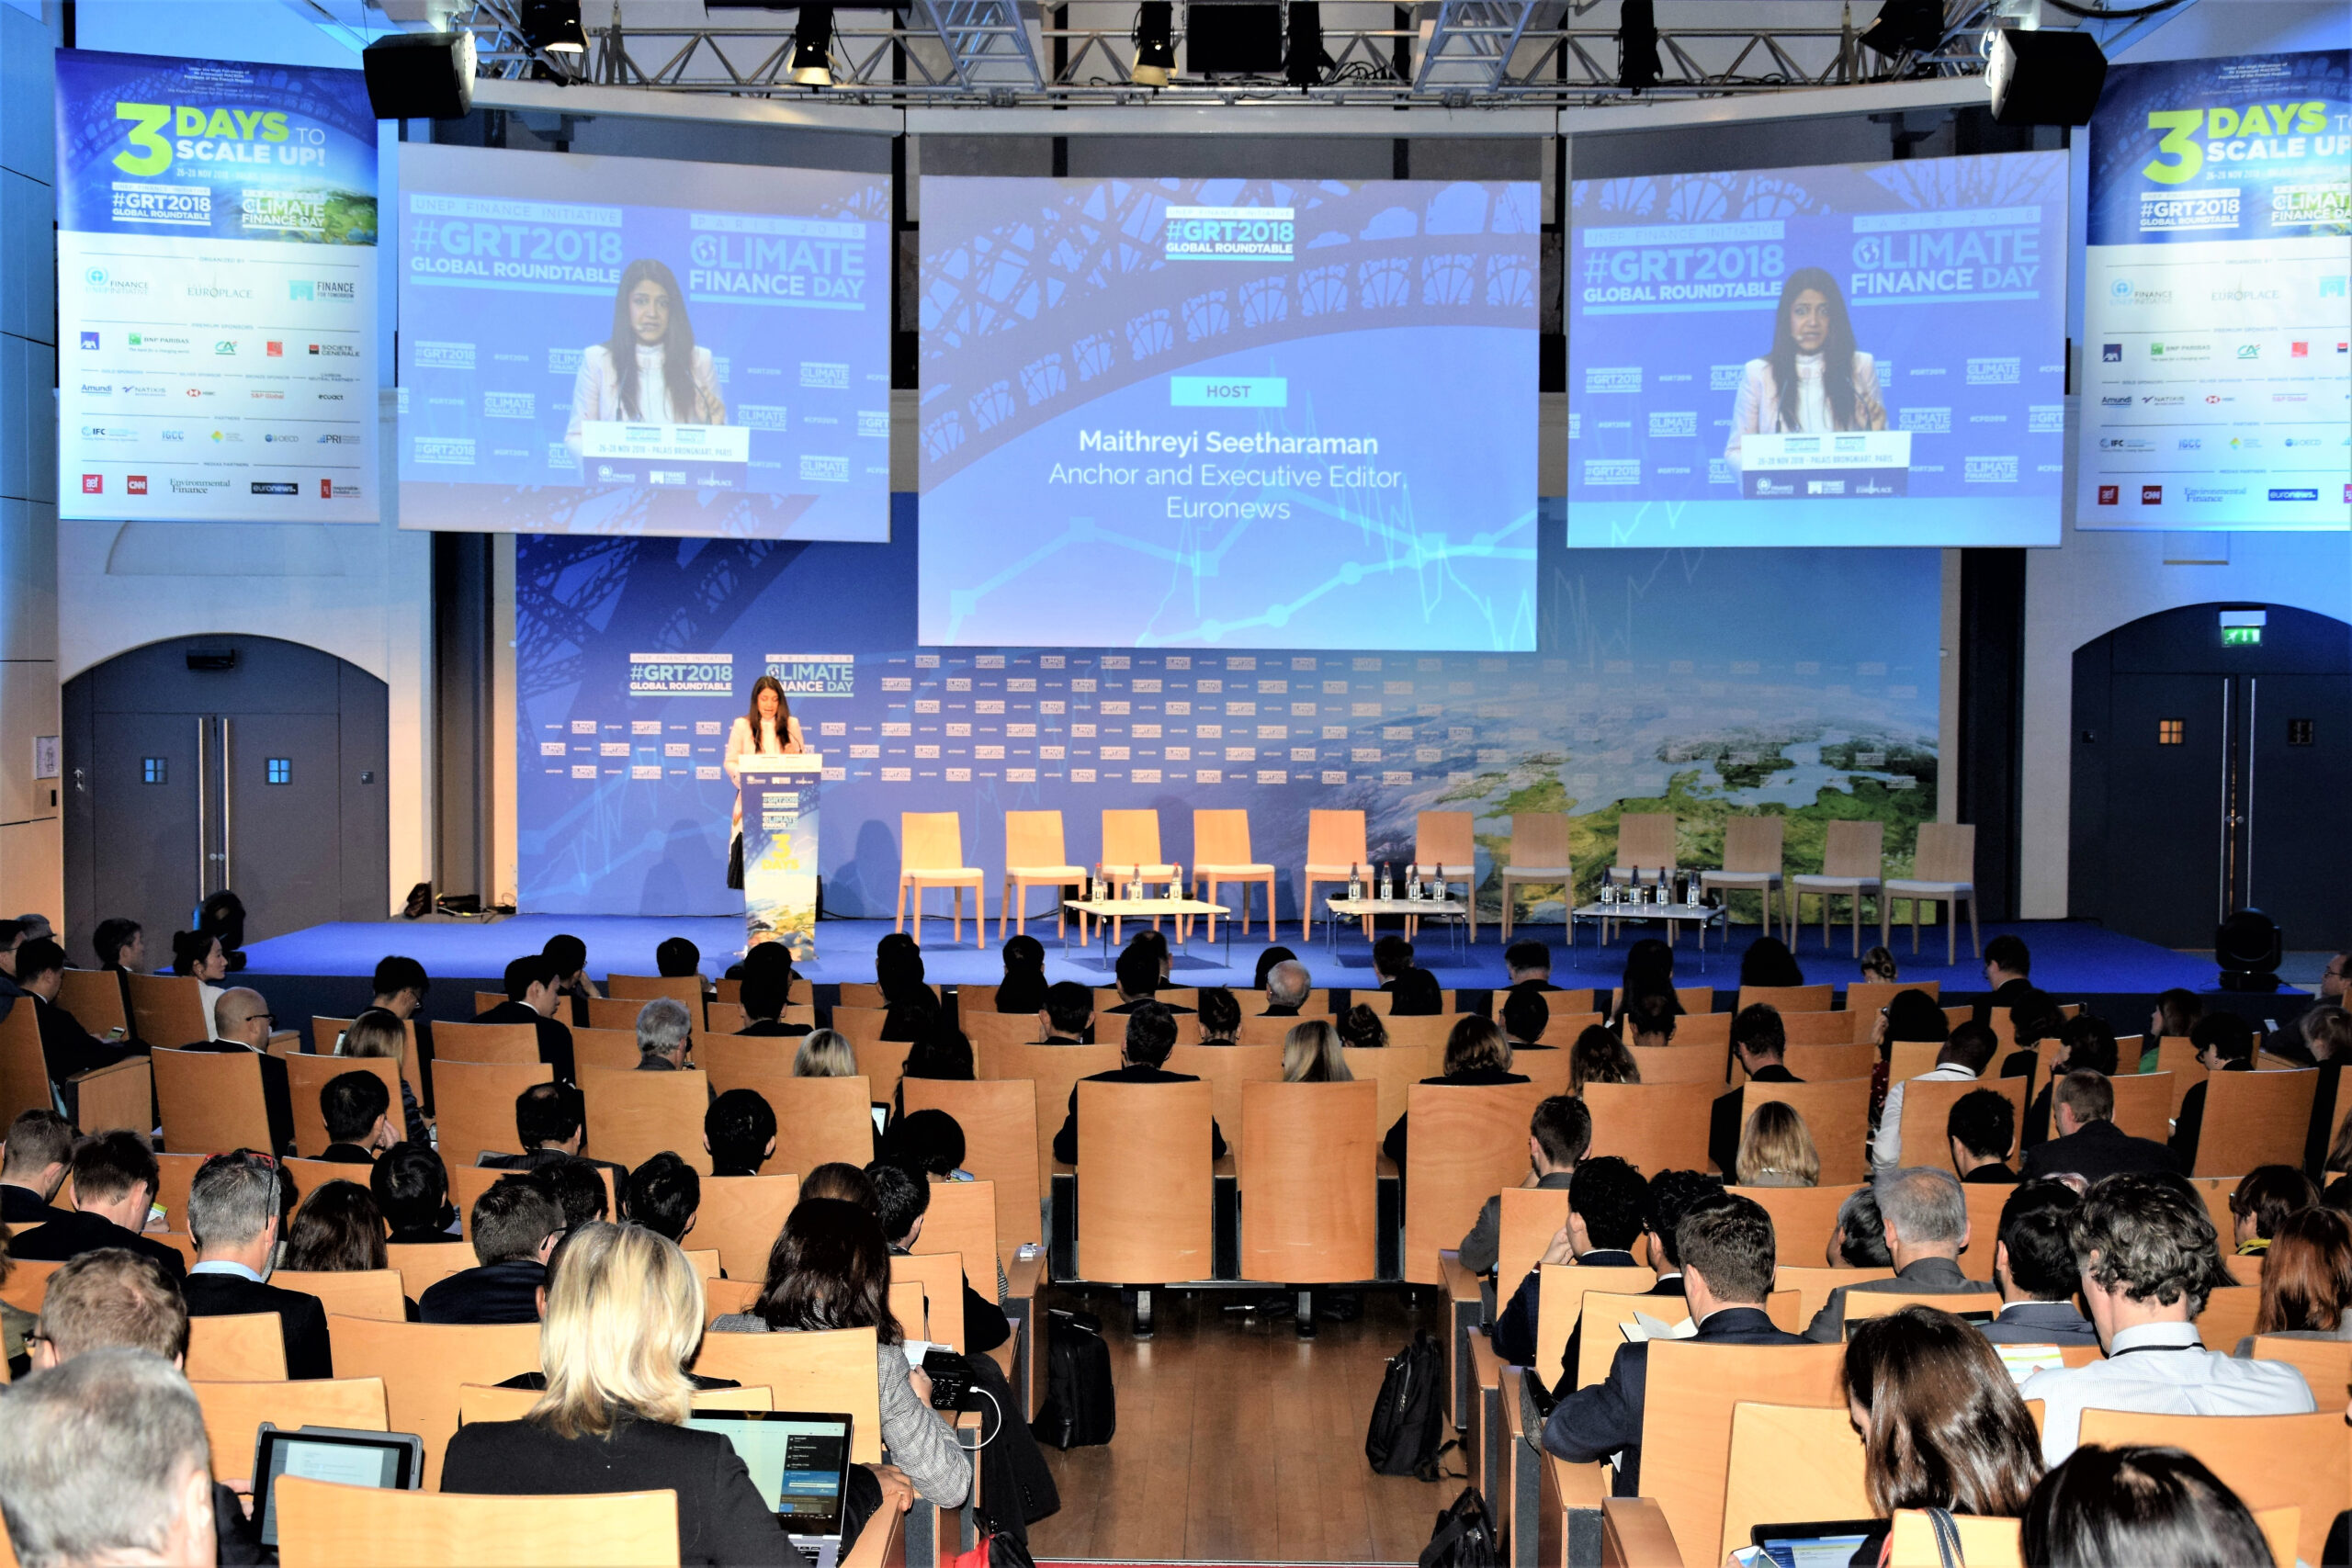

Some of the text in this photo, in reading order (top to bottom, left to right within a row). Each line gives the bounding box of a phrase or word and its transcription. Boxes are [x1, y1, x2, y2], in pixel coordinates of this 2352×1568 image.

[112, 102, 325, 176] 3 DAYS TO
[2142, 101, 2328, 184] 3 DAYS
[176, 140, 325, 167] SCALE UP!
[2207, 137, 2306, 163] SCALE
[112, 192, 211, 212] #GRT2018
[242, 197, 325, 218] CLIMATE
[2273, 192, 2352, 211] CLIMAT
[112, 208, 210, 221] GLOBAL ROUNDTABLE
[415, 198, 617, 223] UNEP FINANCE INITIATIVE
[2141, 198, 2240, 219] #GRT2018
[242, 213, 325, 228] FINANCE DAY
[2140, 215, 2239, 226] GLOBAL ROUNDTABLE
[2271, 209, 2332, 222] FINANCE
[1167, 220, 1295, 243] #GRT2018
[1634, 229, 1696, 243] FINANCE
[411, 219, 623, 265] #GRT2018
[1166, 243, 1294, 254] GLOBAL ROUNDTABLE
[690, 234, 865, 276] CLIMATE
[1852, 228, 2041, 270] CLIMATE
[412, 256, 622, 284] GLOBAL ROUNDTABLE
[1584, 244, 1785, 284] #GRT2018
[110, 280, 148, 289] FINANCE
[690, 269, 865, 299] FINANCE DAY
[1851, 265, 2040, 294] FINANCE DAY
[187, 287, 254, 299] EUROPLACE
[317, 281, 355, 293] FINANCE
[1584, 281, 1782, 303] GLOBAL ROUNDTABLE
[415, 347, 476, 360] #GRT2018
[801, 367, 849, 380] CLIMATE
[1966, 364, 2020, 375] CLIMATE
[1586, 373, 1643, 384] #GRT2018
[81, 384, 112, 392] Amundi
[1206, 385, 1251, 399] HOST
[485, 397, 535, 410] CLIMATE
[739, 410, 786, 423] CLIMATE
[1649, 417, 1697, 428] CLIMATE
[1899, 413, 1951, 424] CLIMATE
[162, 430, 184, 440] IGCC
[325, 434, 342, 444] PRI
[1079, 430, 1379, 457] Maithreyi Seetharaman
[2111, 439, 2124, 447] IFC
[415, 445, 476, 456] #GRT2018
[617, 445, 630, 454] NOV
[652, 446, 673, 455] PALAIS
[715, 448, 733, 457] PARIS
[801, 461, 849, 472] CLIMATE
[1585, 466, 1641, 477] #GRT2018
[1964, 462, 2018, 474] CLIMATE
[1048, 463, 1139, 485] Anchor
[1146, 465, 1193, 485] and
[1201, 465, 1322, 488] Executive
[129, 481, 145, 490] CNN
[170, 478, 231, 487] Environmental
[172, 485, 209, 494] Finance
[2185, 487, 2246, 497] Environmental
[2187, 494, 2223, 502] Finance
[1167, 497, 1291, 520] Euronews
[630, 664, 733, 682] #GRT2018
[765, 663, 854, 681] CLIMATE
[630, 682, 732, 691] GLOBAL ROUNDTABLE
[779, 682, 854, 692] NANCE DAY
[772, 834, 791, 858] 3
[761, 860, 799, 870] DAYS
